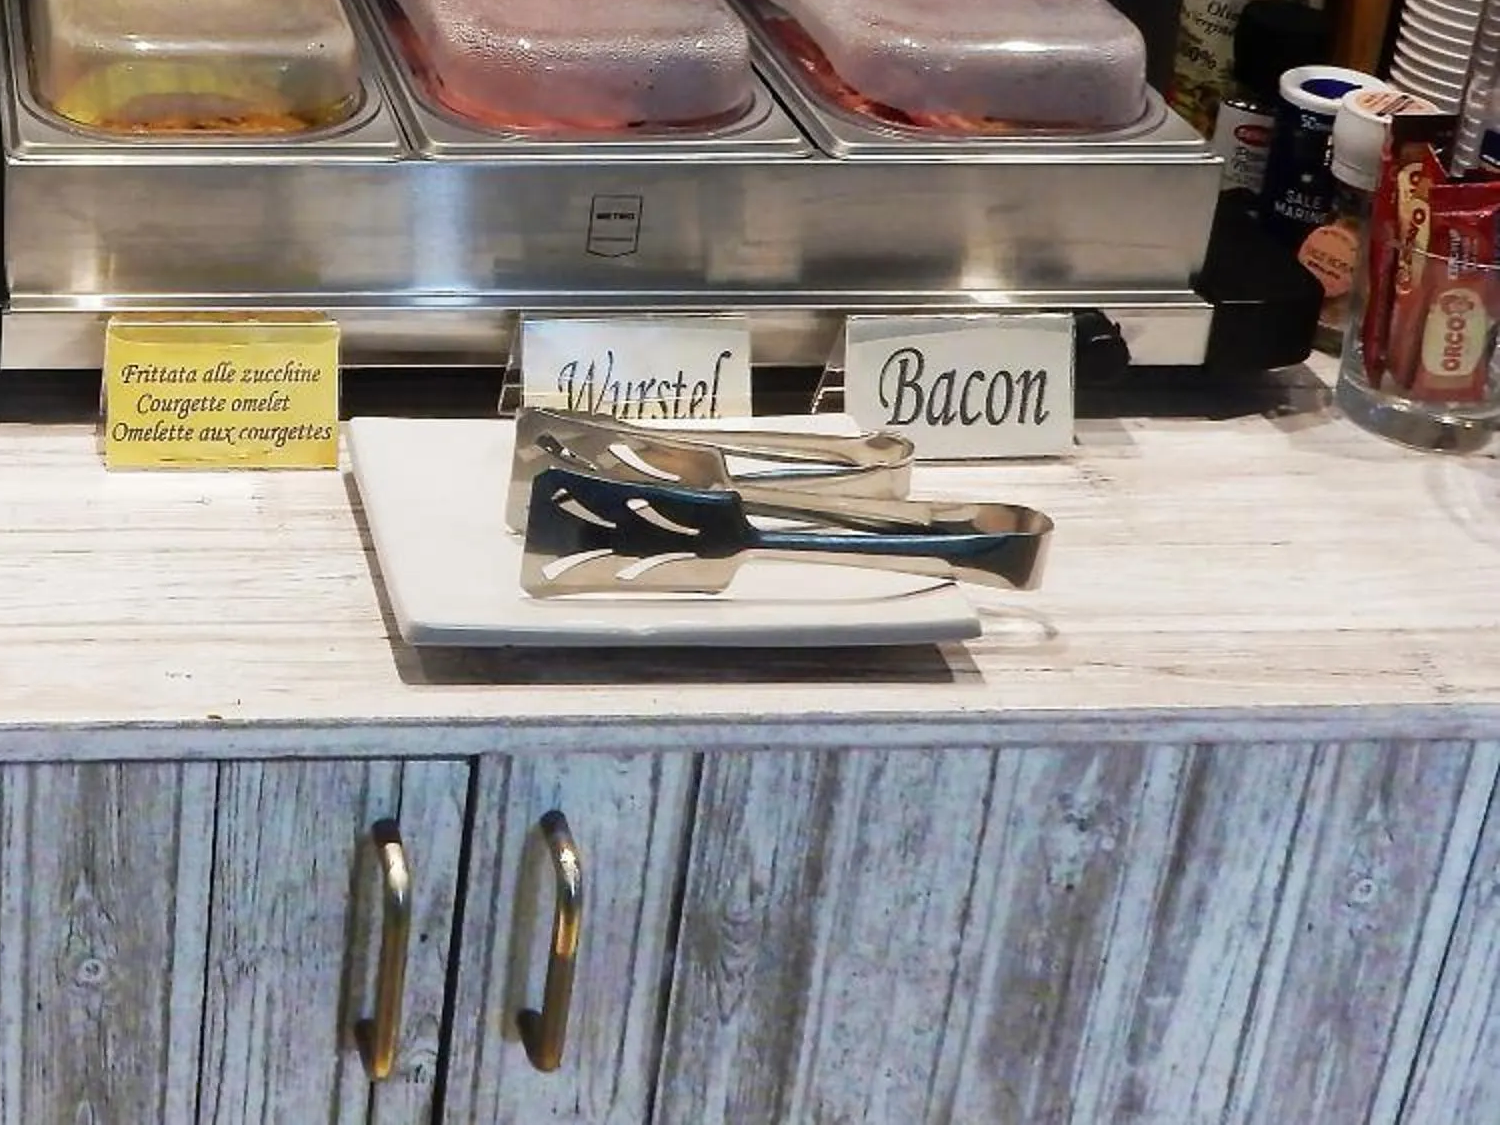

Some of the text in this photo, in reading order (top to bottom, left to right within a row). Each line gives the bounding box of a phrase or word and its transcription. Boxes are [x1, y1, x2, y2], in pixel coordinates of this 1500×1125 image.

[121, 360, 321, 384] Frittata alle zucchine
[558, 350, 732, 419] Wurstel
[879, 347, 1050, 425] Bacon
[137, 391, 291, 418] Courgette omelet
[112, 421, 333, 447] Omelette aux courgettes
